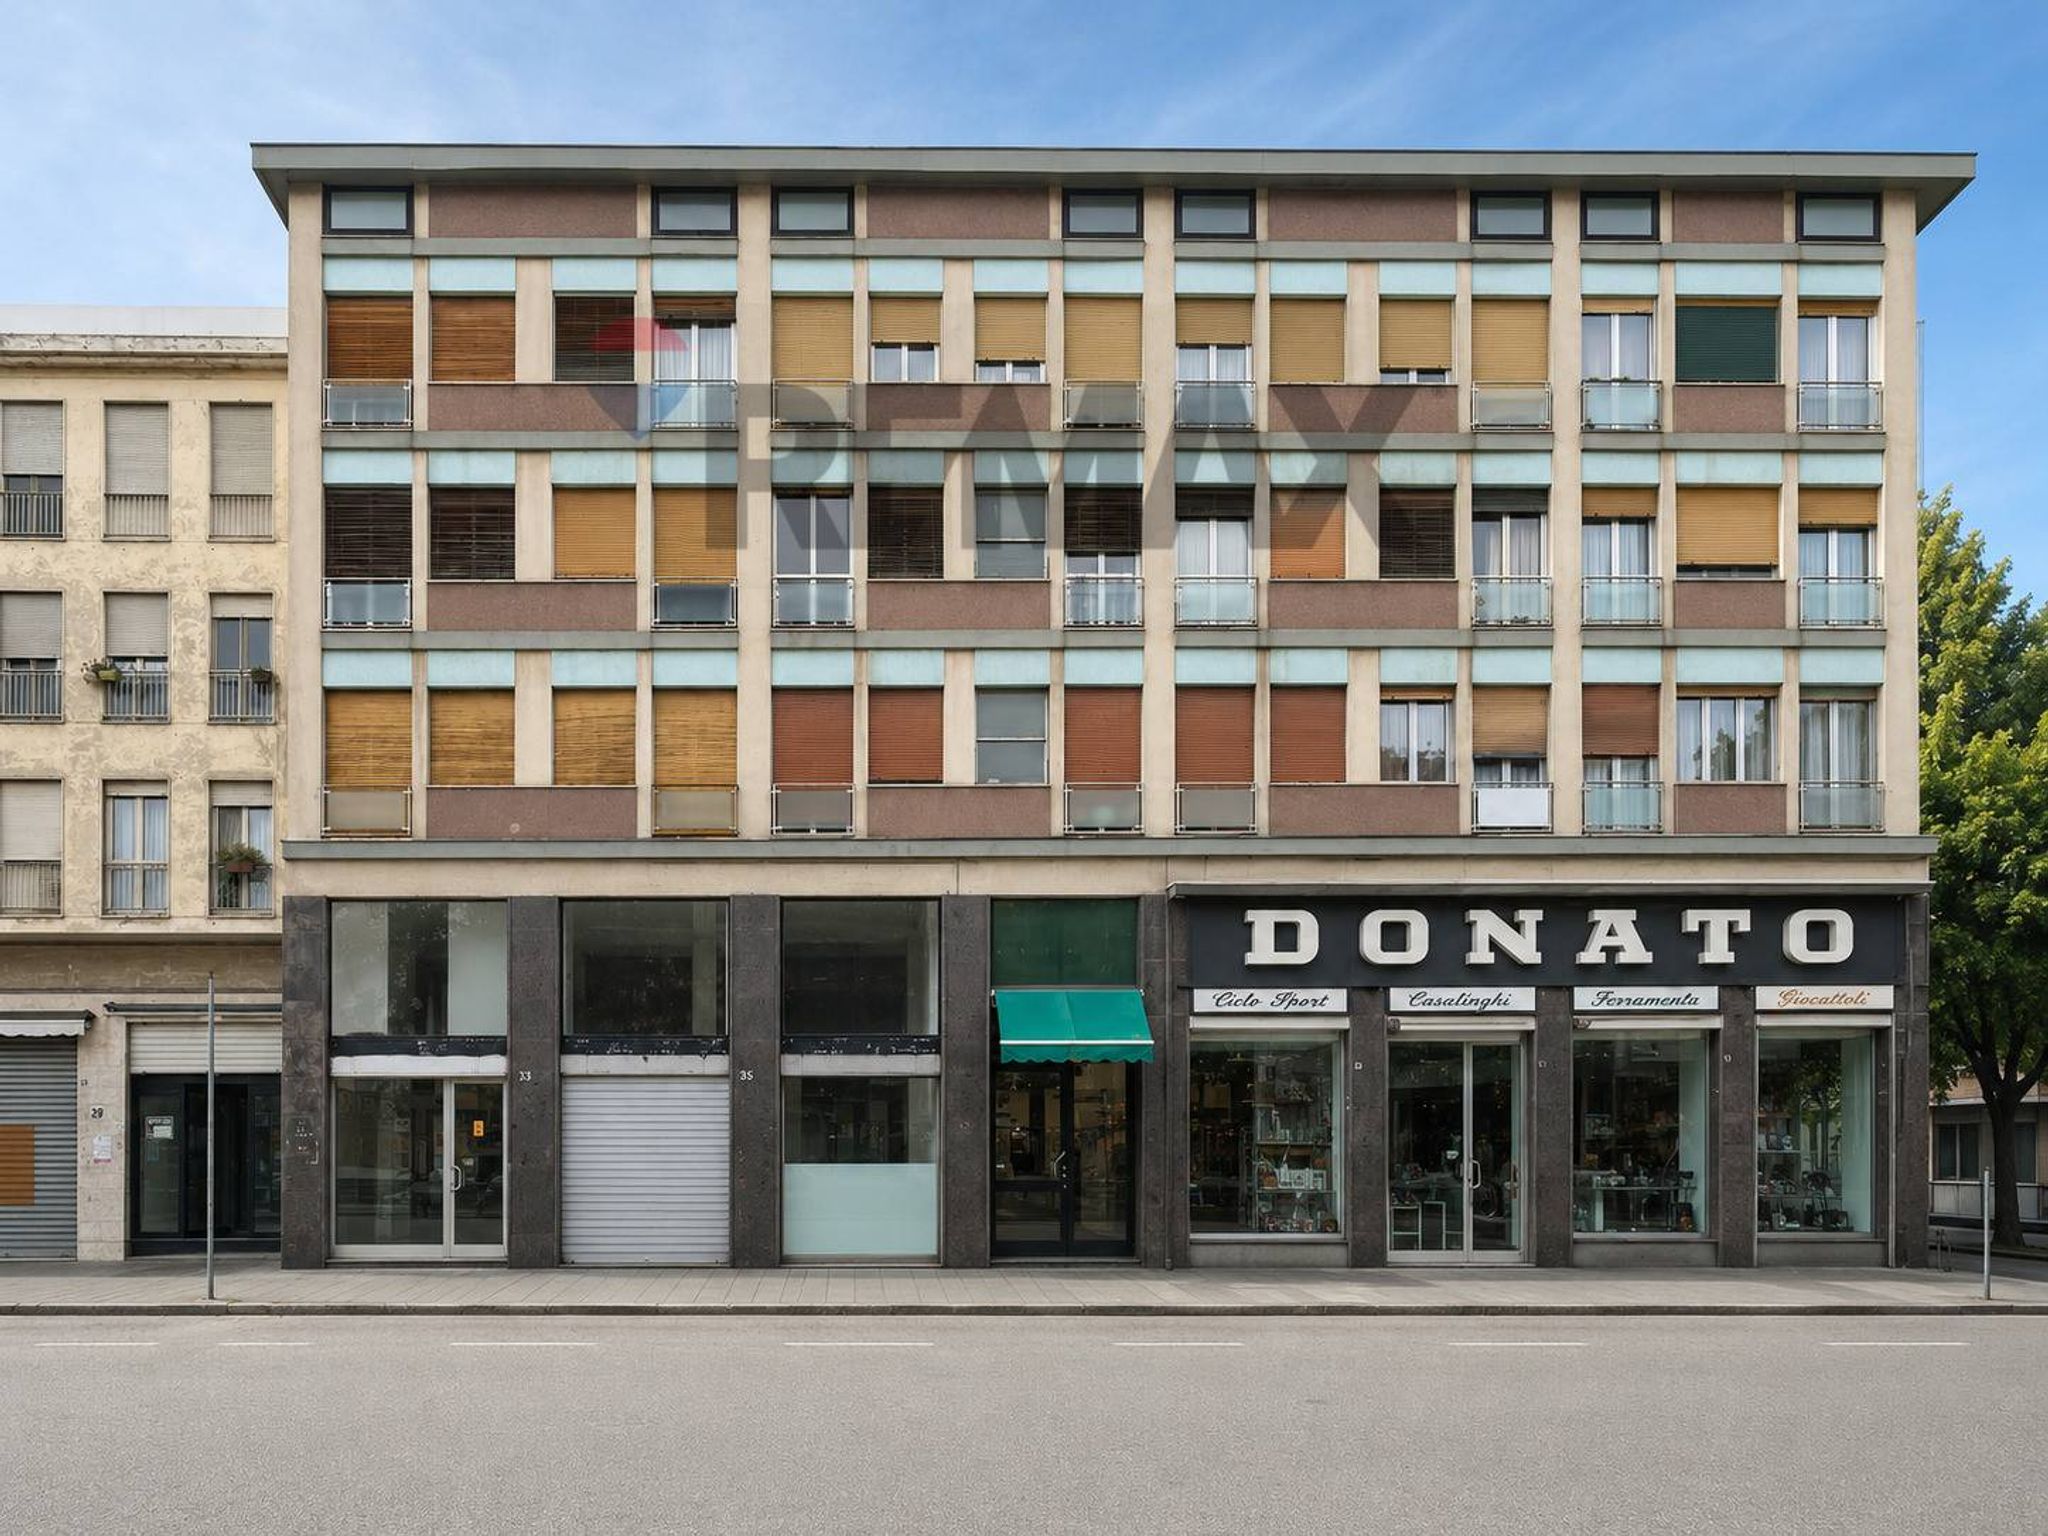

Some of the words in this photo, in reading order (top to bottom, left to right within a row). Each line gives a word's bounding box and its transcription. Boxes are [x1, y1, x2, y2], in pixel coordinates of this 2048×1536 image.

[1244, 909, 1854, 965] DONATO
[1212, 991, 1263, 1008] Ciclo
[1270, 991, 1330, 1010] Sport
[1408, 990, 1513, 1013] Casalinghi
[1591, 990, 1701, 1008] Ferramenta
[1777, 988, 1871, 1008] Giocattoli
